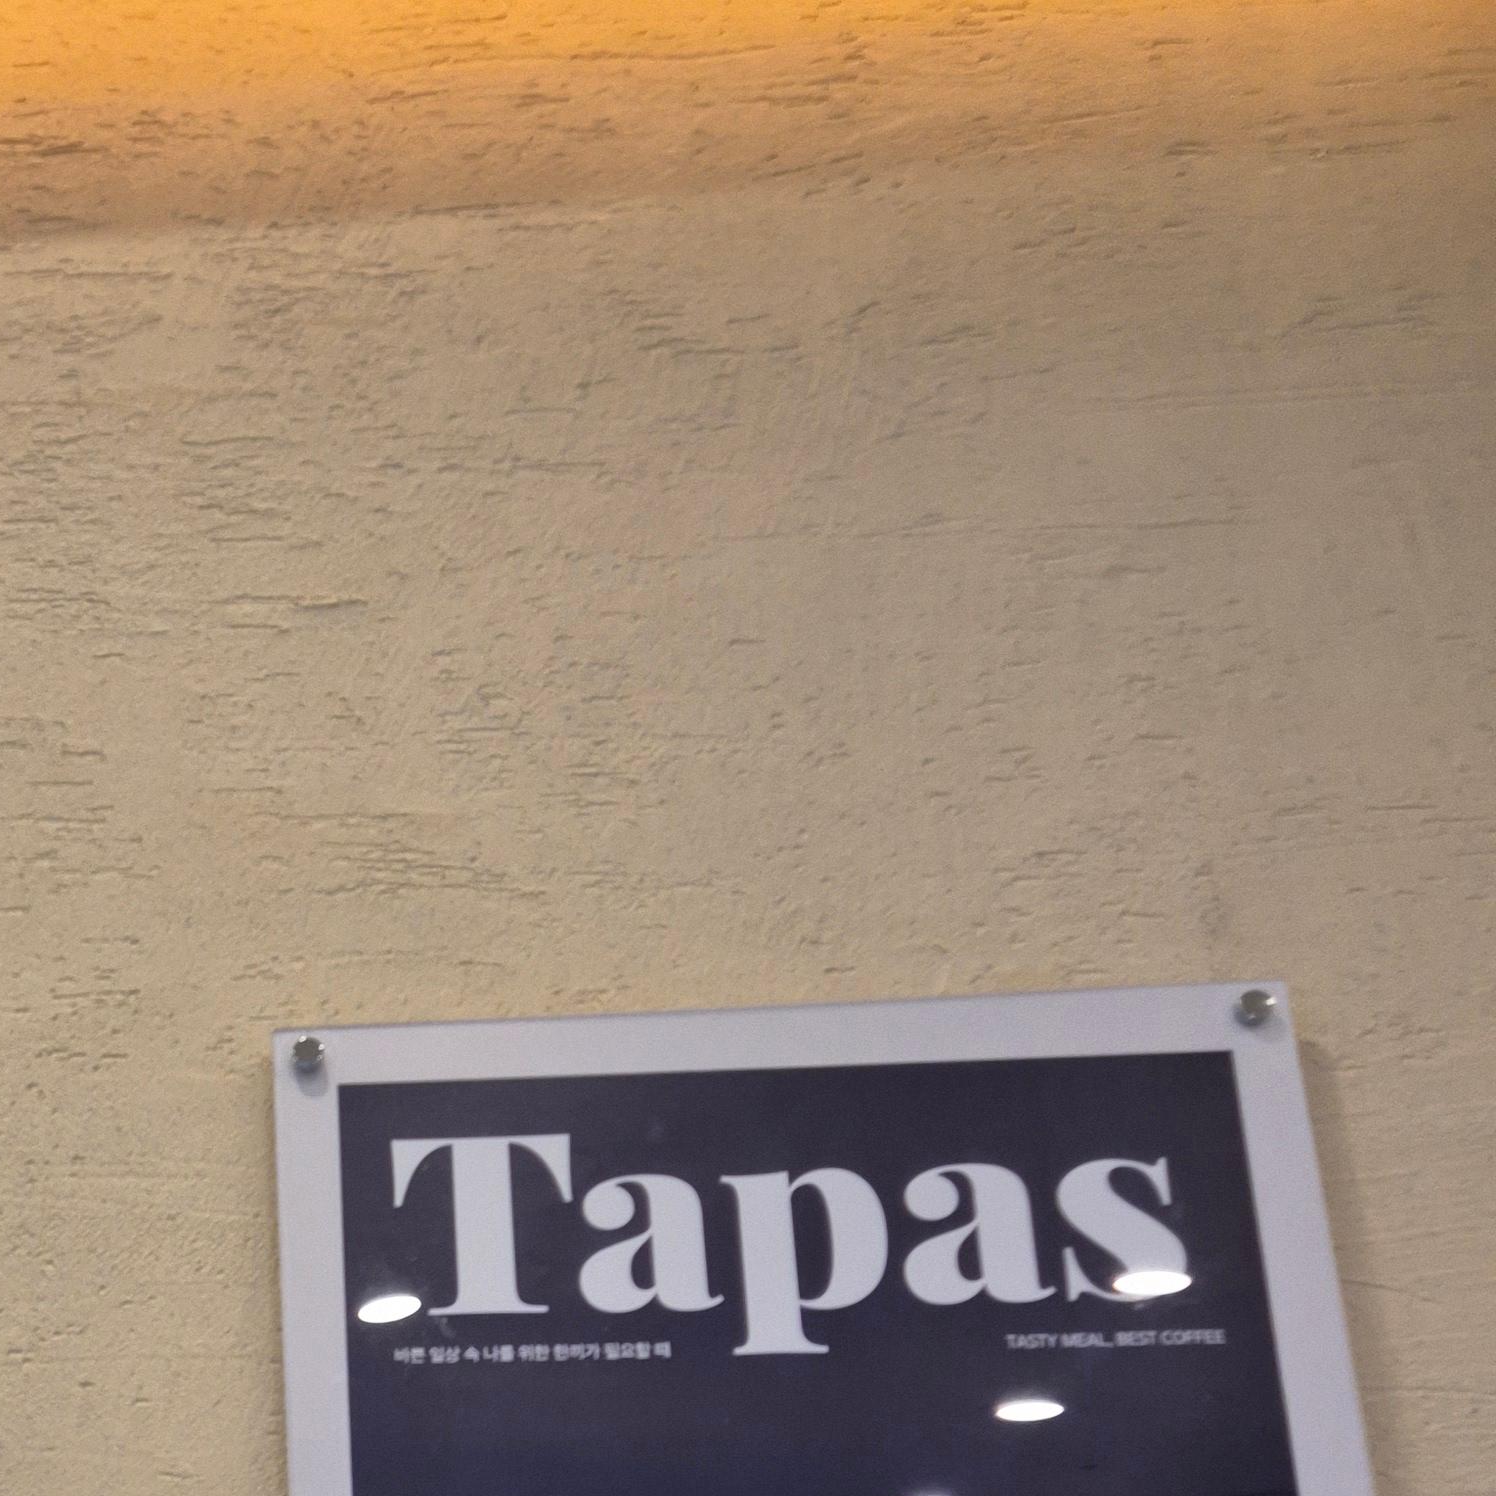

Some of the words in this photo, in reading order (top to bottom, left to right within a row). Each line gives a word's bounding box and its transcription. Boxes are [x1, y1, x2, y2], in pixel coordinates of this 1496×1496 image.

[390, 1133, 1188, 1356] Tapas
[1004, 1333, 1058, 1349] TASTY
[1115, 1330, 1157, 1347] BEST
[1160, 1328, 1227, 1345] COFFEE
